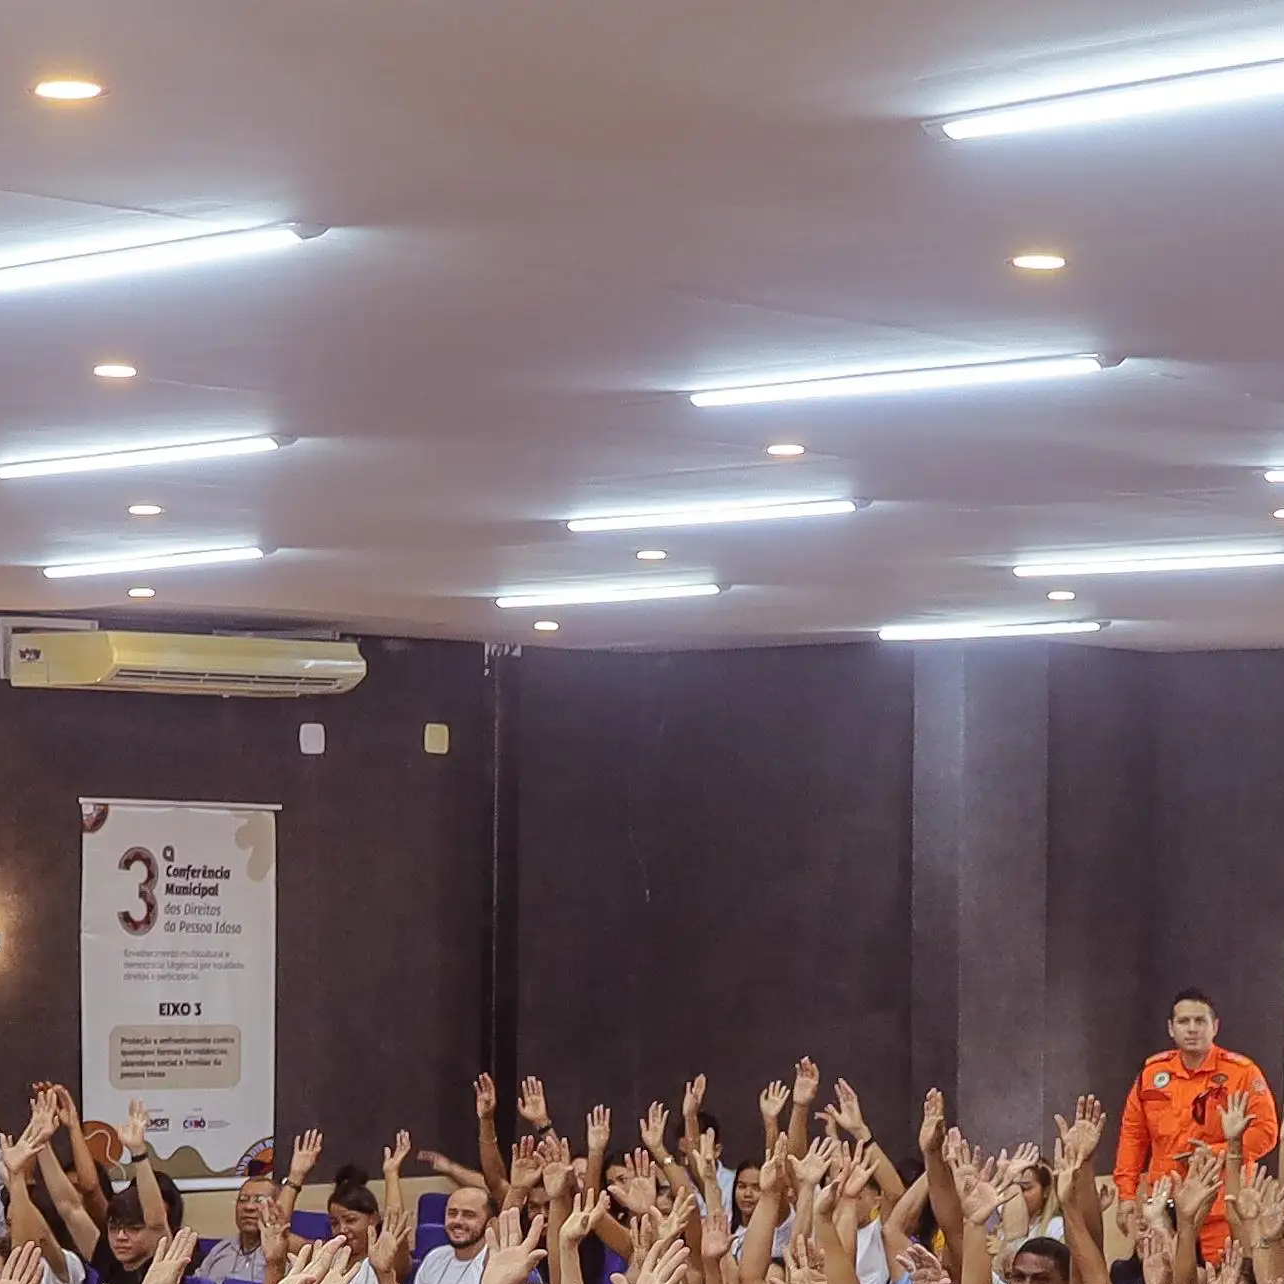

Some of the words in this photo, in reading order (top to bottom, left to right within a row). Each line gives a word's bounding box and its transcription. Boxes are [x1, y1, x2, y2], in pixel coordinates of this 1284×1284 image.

[165, 864, 231, 881] Conferência
[165, 883, 219, 899] Municipal
[164, 903, 181, 916] dos
[183, 903, 221, 916] Direitos
[164, 921, 176, 932] da
[179, 921, 212, 934] Pessoa
[215, 922, 242, 935] Idosa
[159, 1003, 191, 1016] EIXO
[194, 1003, 202, 1016] 3
